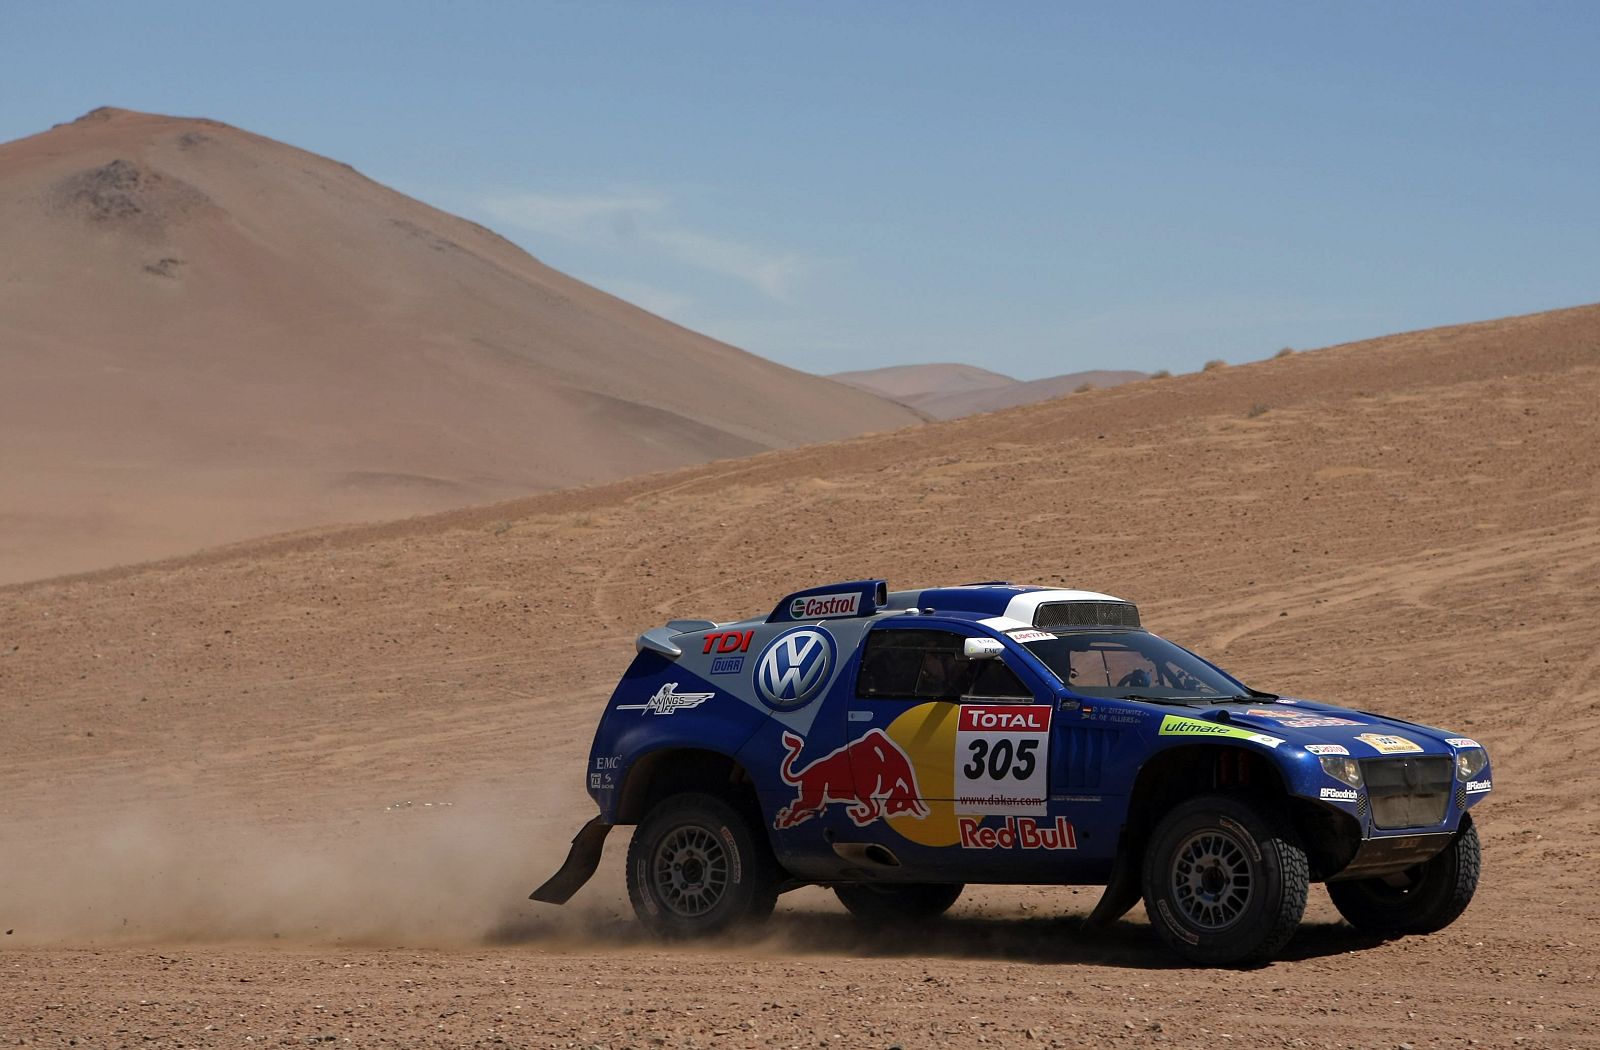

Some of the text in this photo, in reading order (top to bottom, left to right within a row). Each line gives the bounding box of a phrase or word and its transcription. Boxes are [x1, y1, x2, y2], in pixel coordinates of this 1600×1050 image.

[805, 595, 856, 616] Castrol
[703, 630, 754, 654] TDI
[656, 704, 676, 714] LIFE
[968, 709, 1041, 728] TOTAL
[1164, 721, 1230, 734] ultimate
[963, 738, 1040, 781] 305
[1320, 788, 1358, 799] BFGoodrich
[1466, 780, 1492, 791] BFGoodric
[959, 794, 1042, 806] www.dakar.com
[958, 815, 1077, 850] Red Bull
